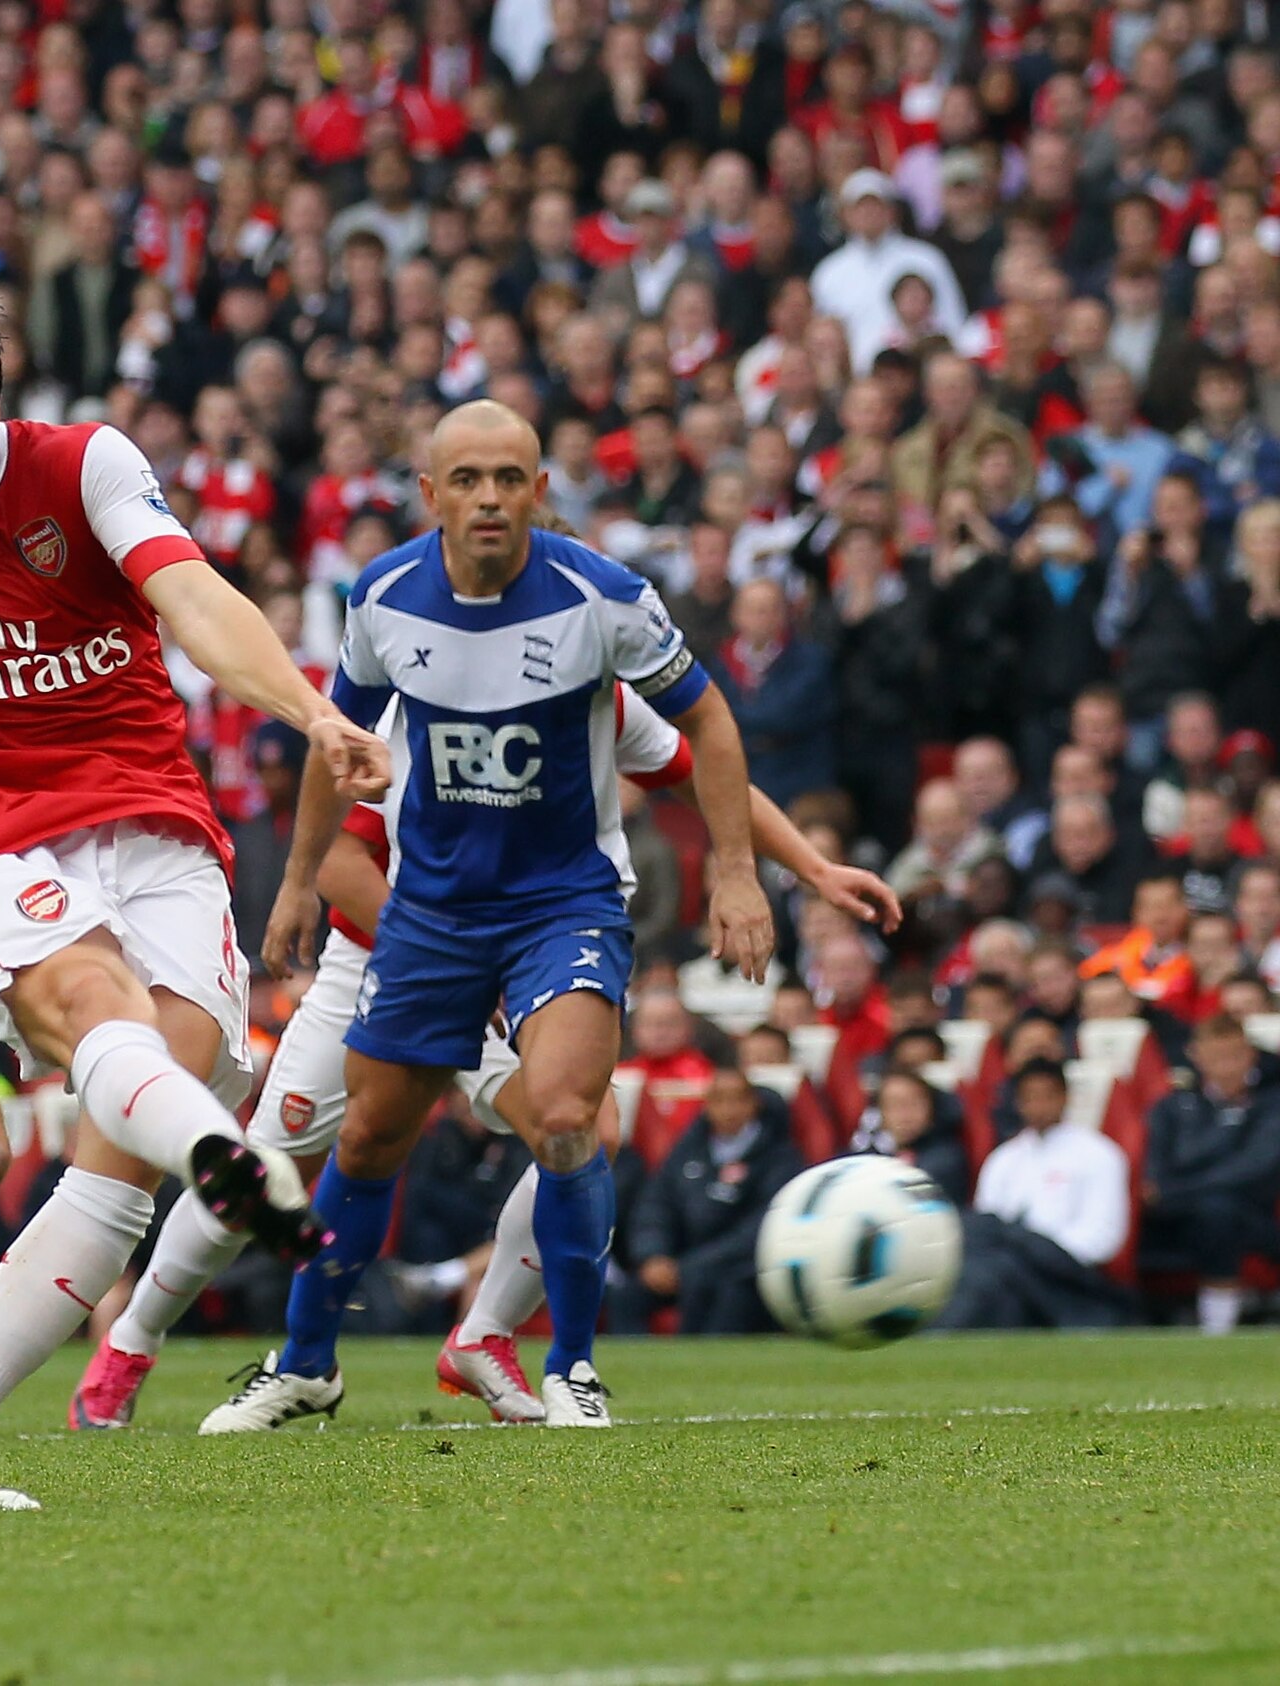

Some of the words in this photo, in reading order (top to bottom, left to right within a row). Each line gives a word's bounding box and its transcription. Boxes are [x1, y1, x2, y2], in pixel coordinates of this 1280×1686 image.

[21, 524, 53, 548] Arsenal
[428, 723, 542, 790] F&C
[23, 883, 57, 907] Arsenal
